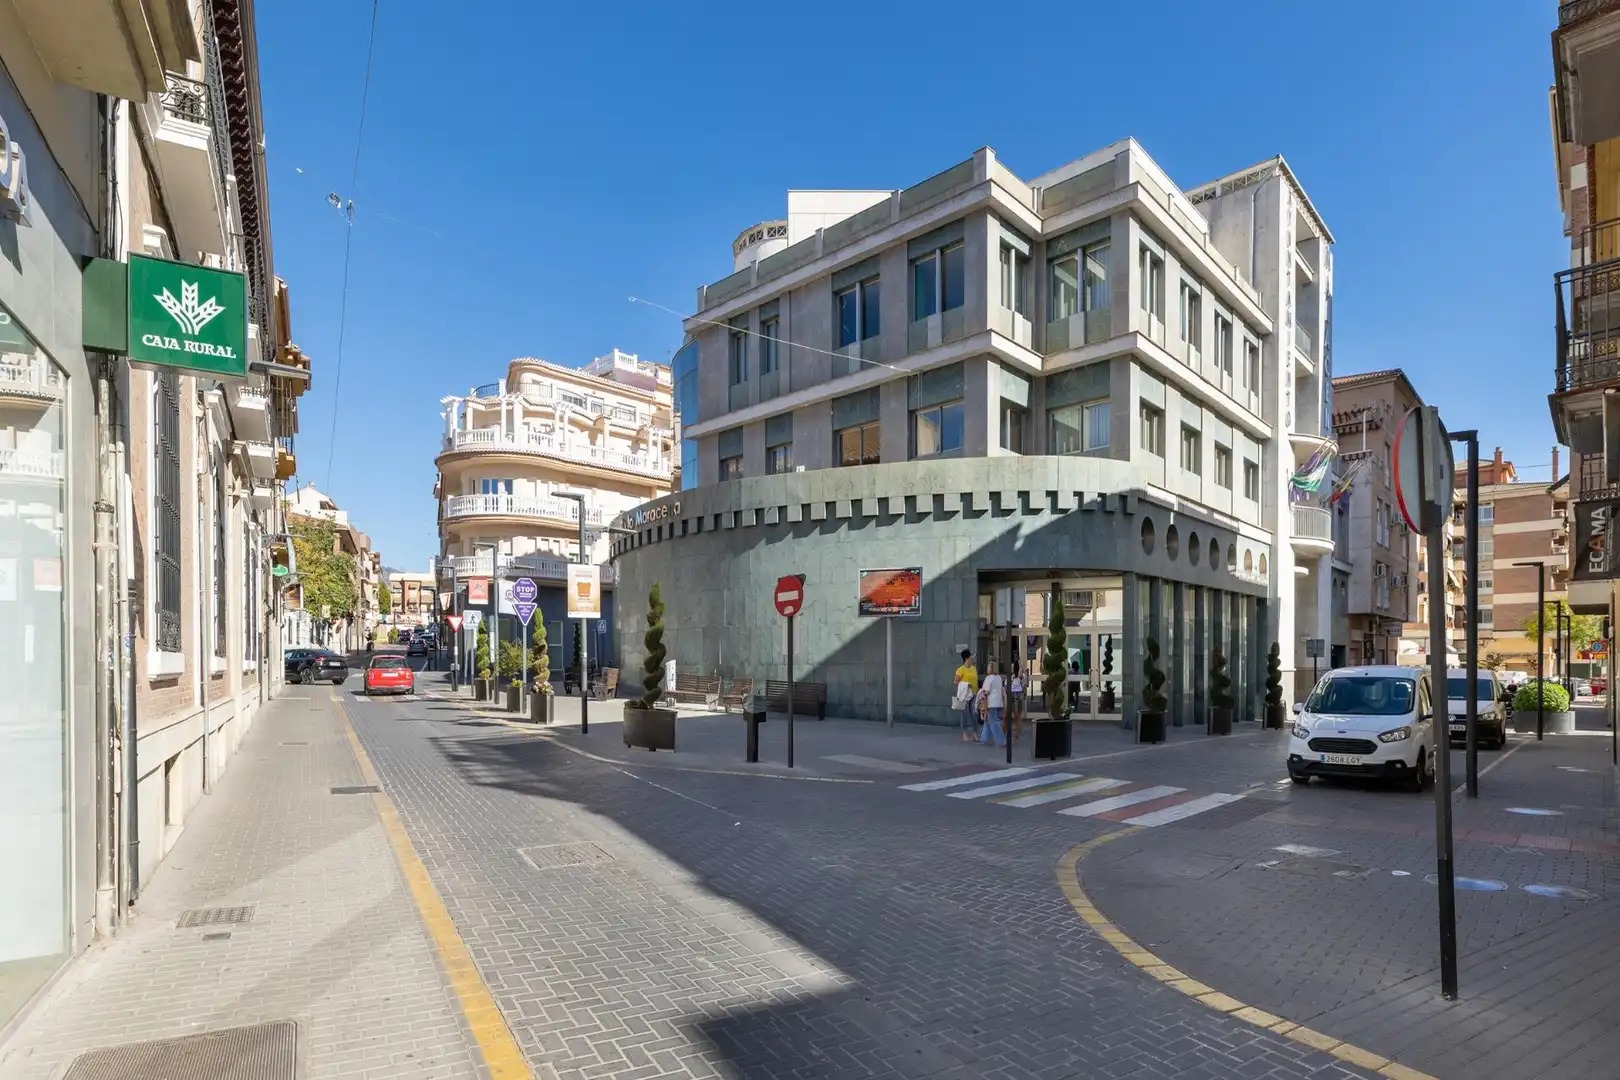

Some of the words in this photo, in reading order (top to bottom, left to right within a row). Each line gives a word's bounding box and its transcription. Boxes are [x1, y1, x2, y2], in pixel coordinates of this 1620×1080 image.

[142, 334, 181, 350] CAJA
[183, 340, 237, 359] RURAL
[636, 501, 681, 526] Maracea
[1588, 506, 1606, 573] ECAMA
